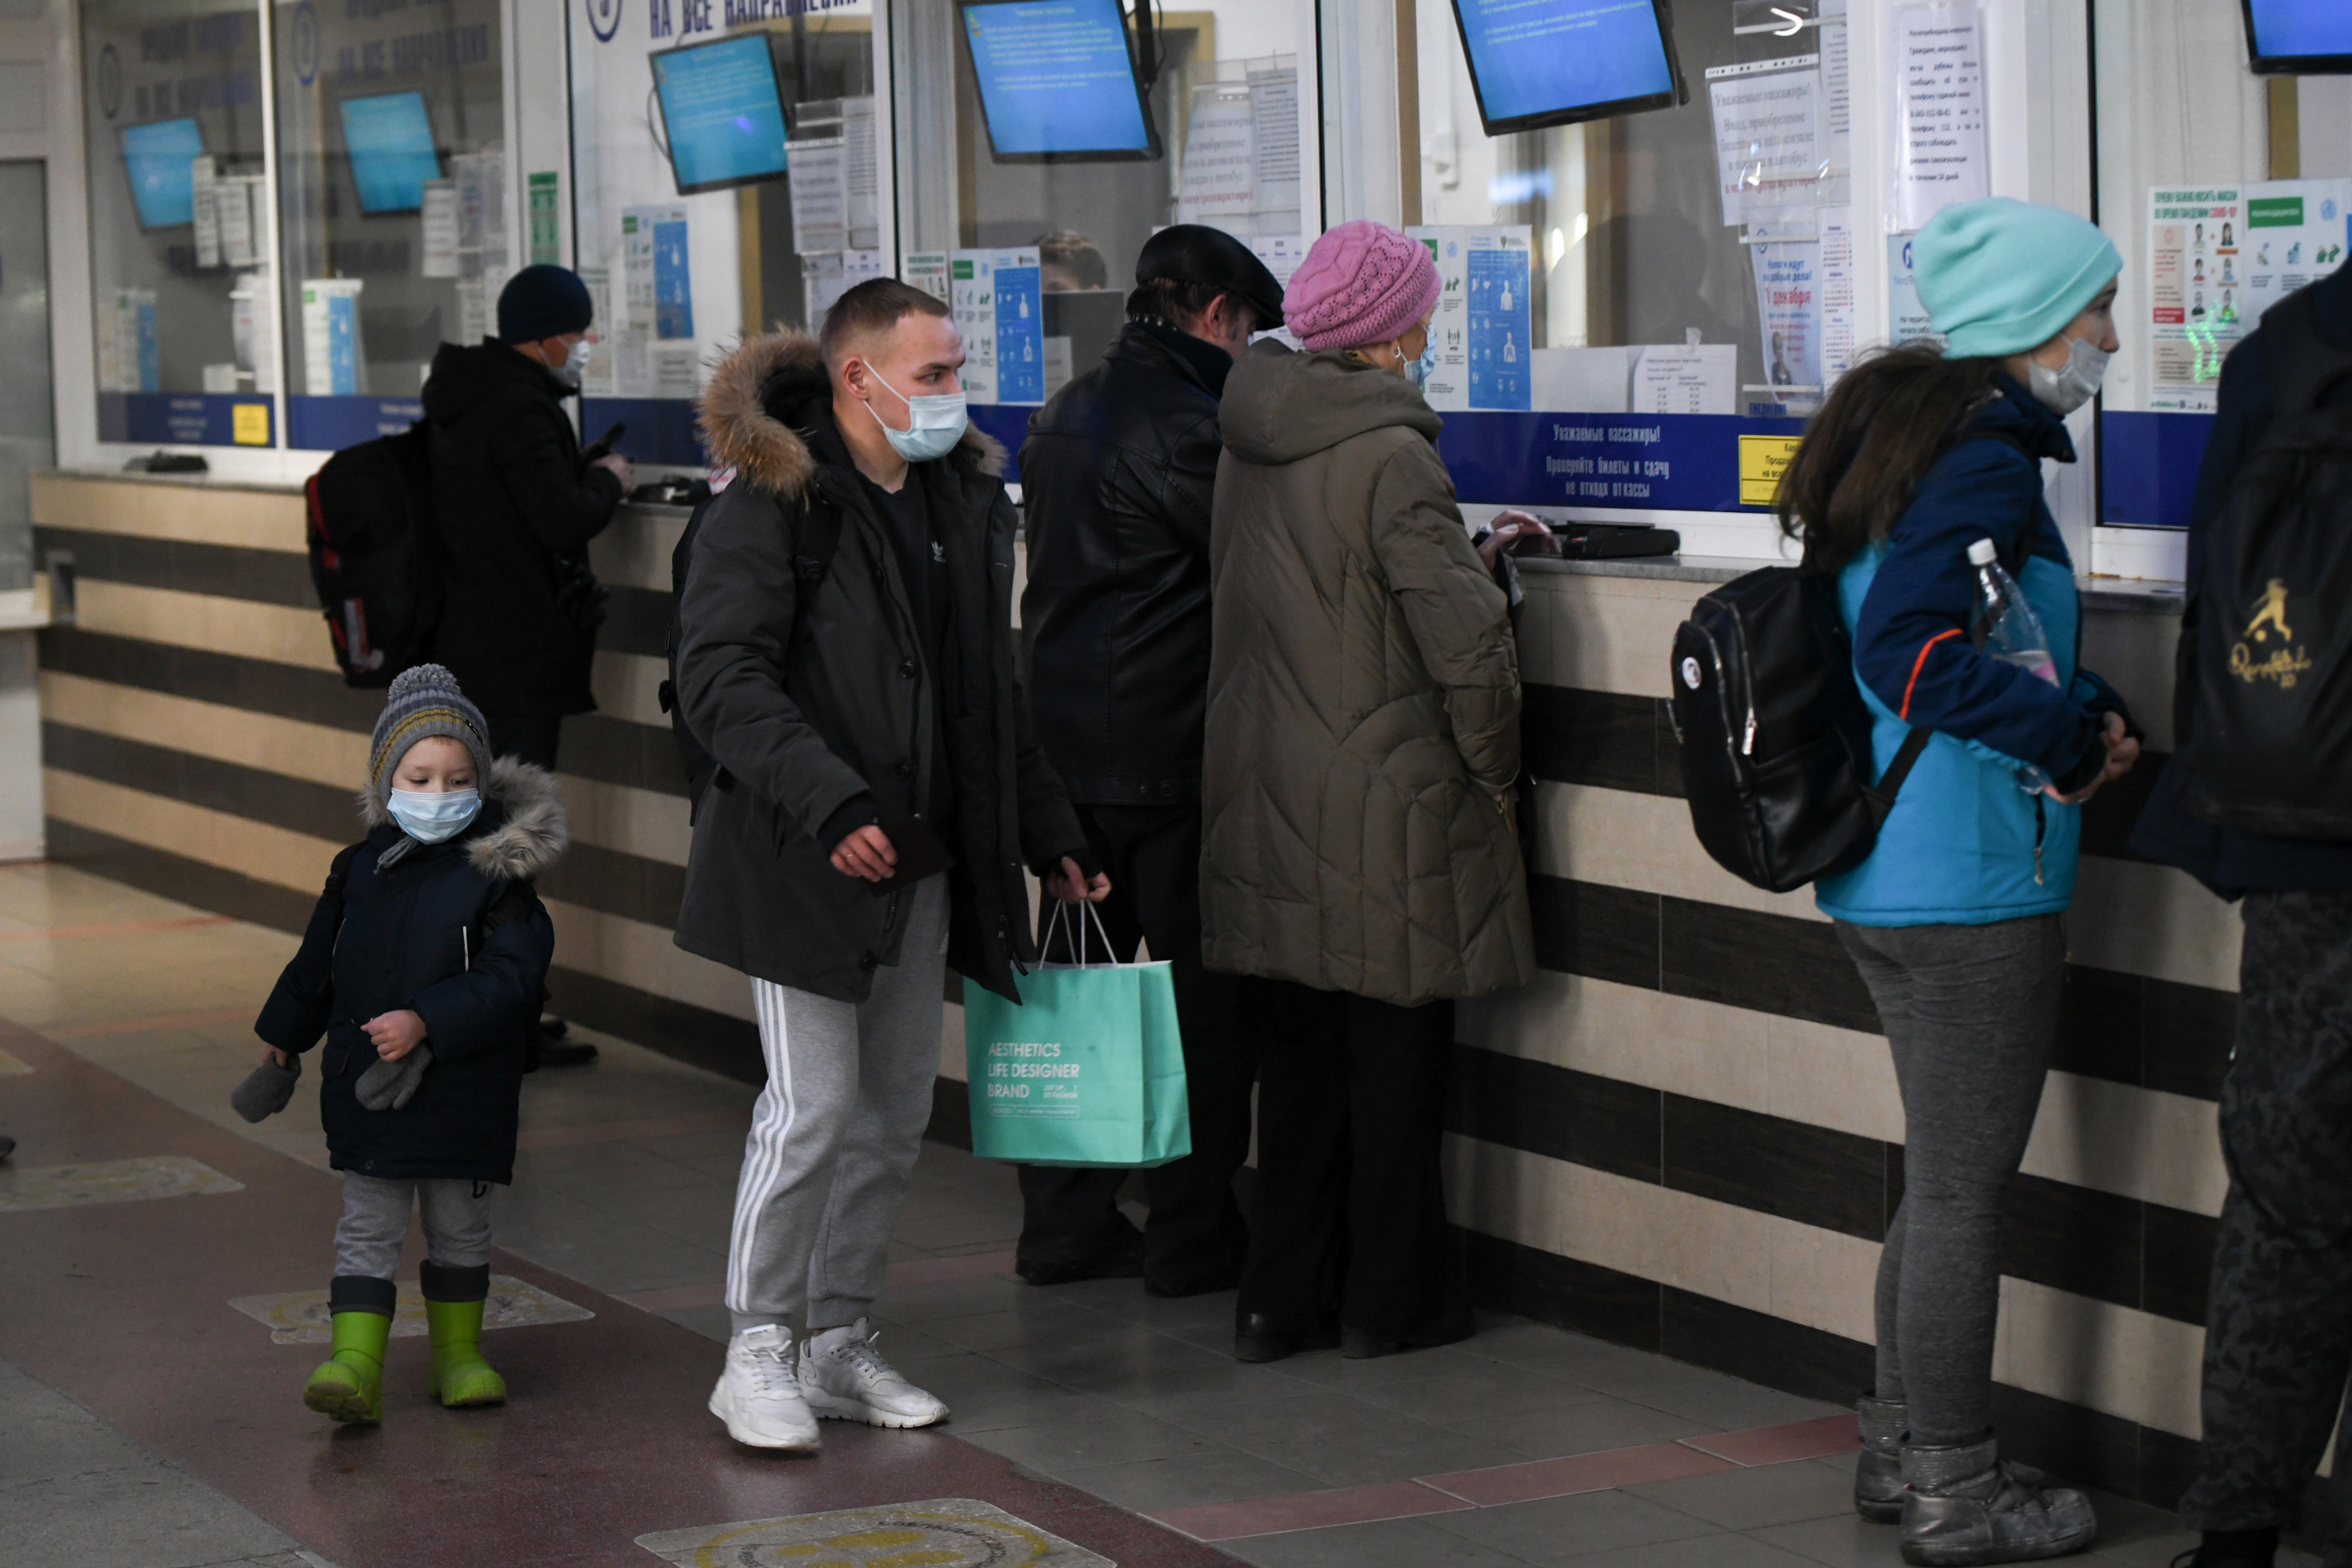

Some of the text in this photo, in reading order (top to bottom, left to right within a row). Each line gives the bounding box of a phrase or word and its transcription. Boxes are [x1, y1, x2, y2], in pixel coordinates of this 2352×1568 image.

[650, 0, 672, 38] НА
[1773, 285, 1811, 310] декабря
[1553, 424, 1661, 445] Уважаемые пассажиры!
[1546, 456, 1670, 480] Проверяйте билеты и сдачу
[1566, 481, 1650, 498] не отходя от кассы
[989, 1042, 1061, 1058] AESTHETICS
[988, 1063, 1080, 1079] LIFE DESIGNER
[988, 1083, 1030, 1098] BRAND
